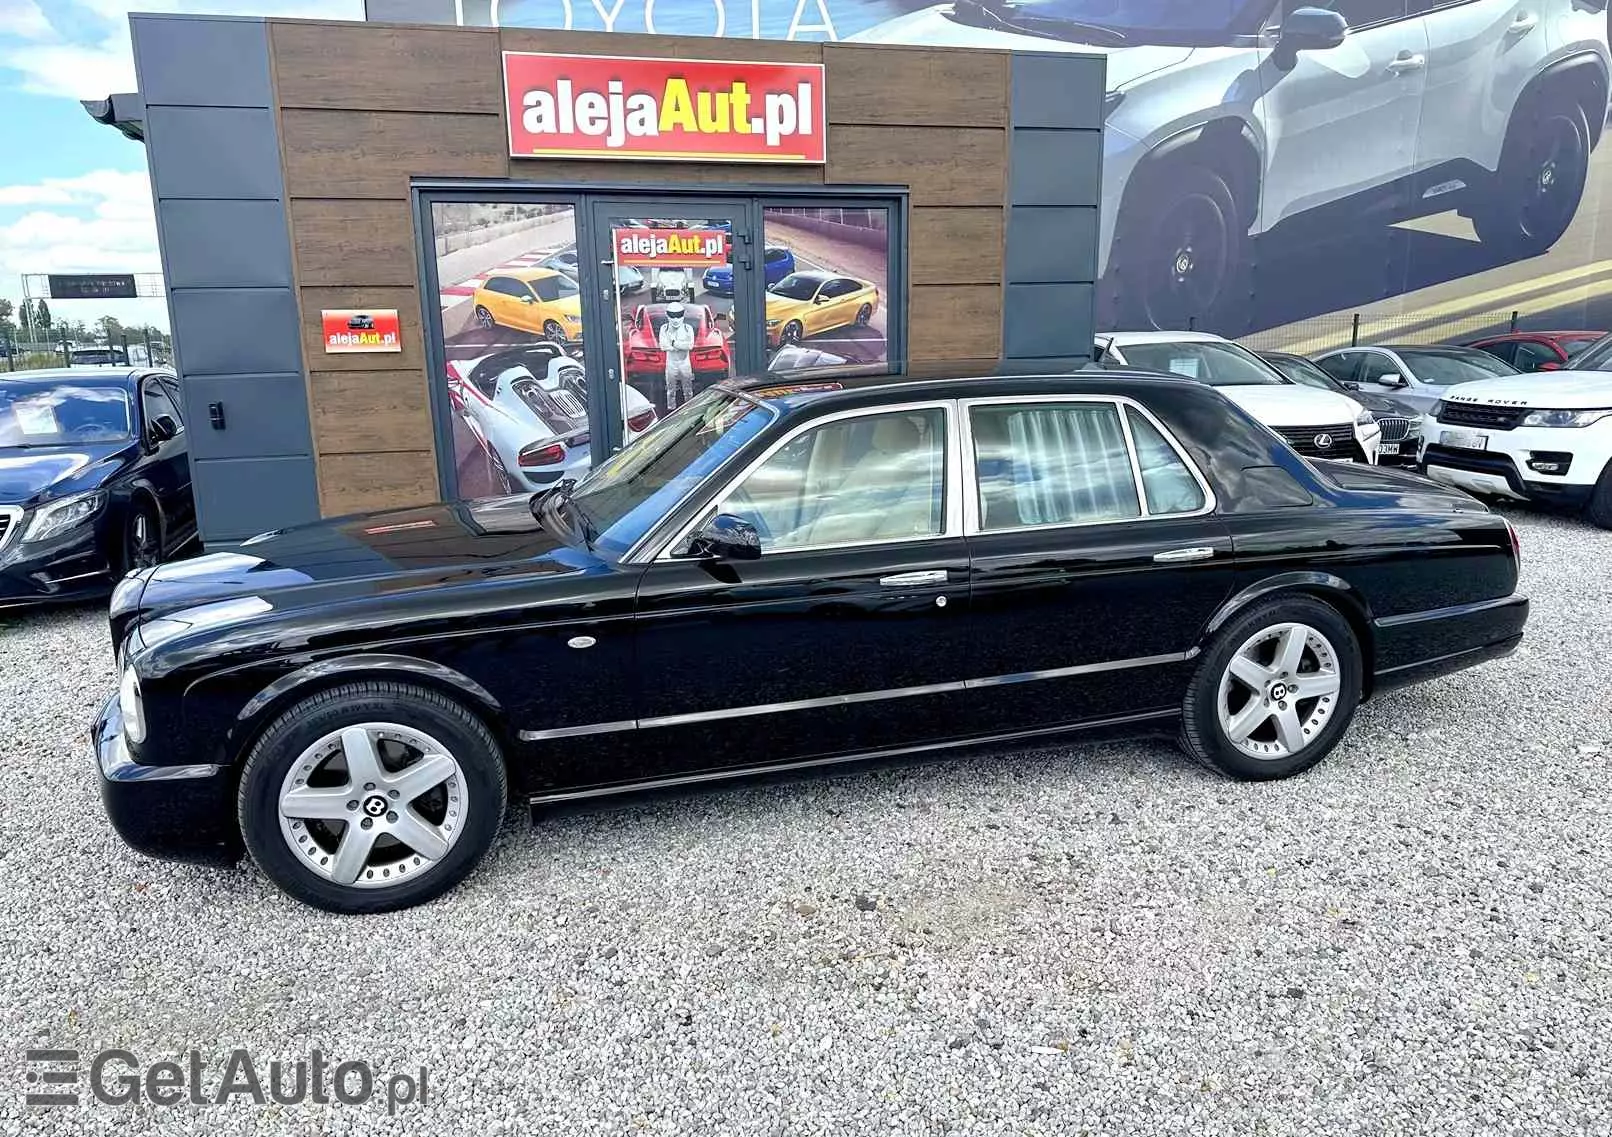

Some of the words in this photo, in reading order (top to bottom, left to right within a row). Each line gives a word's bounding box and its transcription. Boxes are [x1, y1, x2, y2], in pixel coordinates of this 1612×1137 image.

[522, 78, 812, 147] alejaAut.pl
[621, 233, 723, 258] alejaAut.pl
[329, 331, 397, 346] alejaAut.pl
